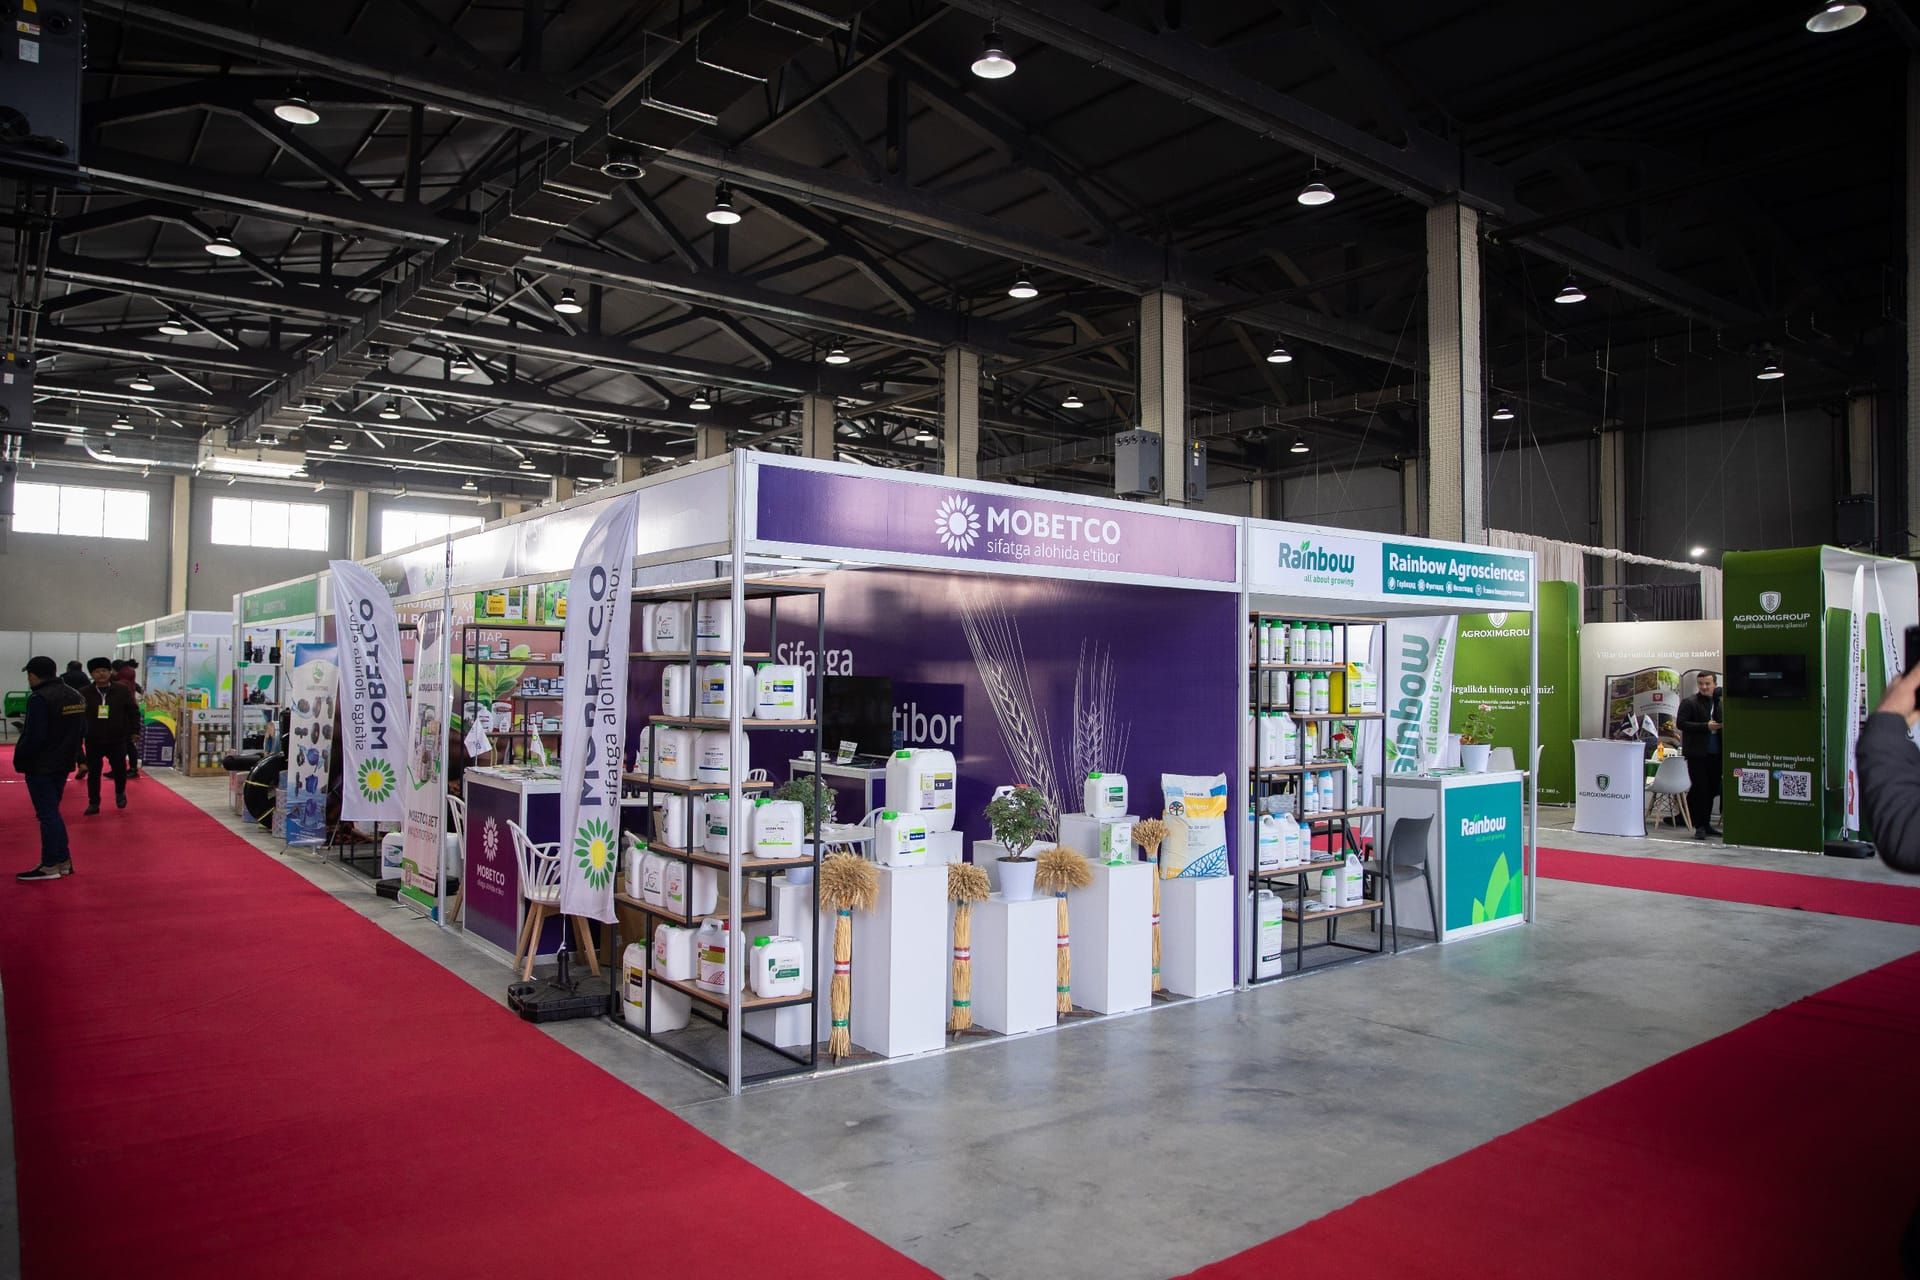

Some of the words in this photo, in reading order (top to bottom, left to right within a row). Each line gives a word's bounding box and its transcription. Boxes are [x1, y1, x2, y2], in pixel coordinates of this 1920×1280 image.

[987, 507, 1120, 545] MOBETCO
[987, 539, 1031, 560] sifatga
[1034, 543, 1080, 560] alohida
[1083, 548, 1120, 564] e'tibor
[1278, 542, 1355, 573] Rainbow
[1389, 552, 1447, 575] Rainbow
[1448, 558, 1525, 582] Agrosciences
[1304, 575, 1312, 583] all
[1313, 576, 1330, 584] about
[1331, 578, 1355, 587] growing
[1733, 613, 1811, 622] AGROXIMGROUP
[1461, 628, 1530, 638] AGROXIMGROU
[1691, 650, 1720, 658] tanlov!
[1489, 684, 1519, 696] himoya
[1390, 634, 1430, 774] ainbow
[1428, 695, 1440, 733] about
[1426, 735, 1438, 755] all
[606, 733, 620, 808] sifatga
[1461, 815, 1506, 837] Rainbow
[476, 863, 505, 887] MOBETCO
